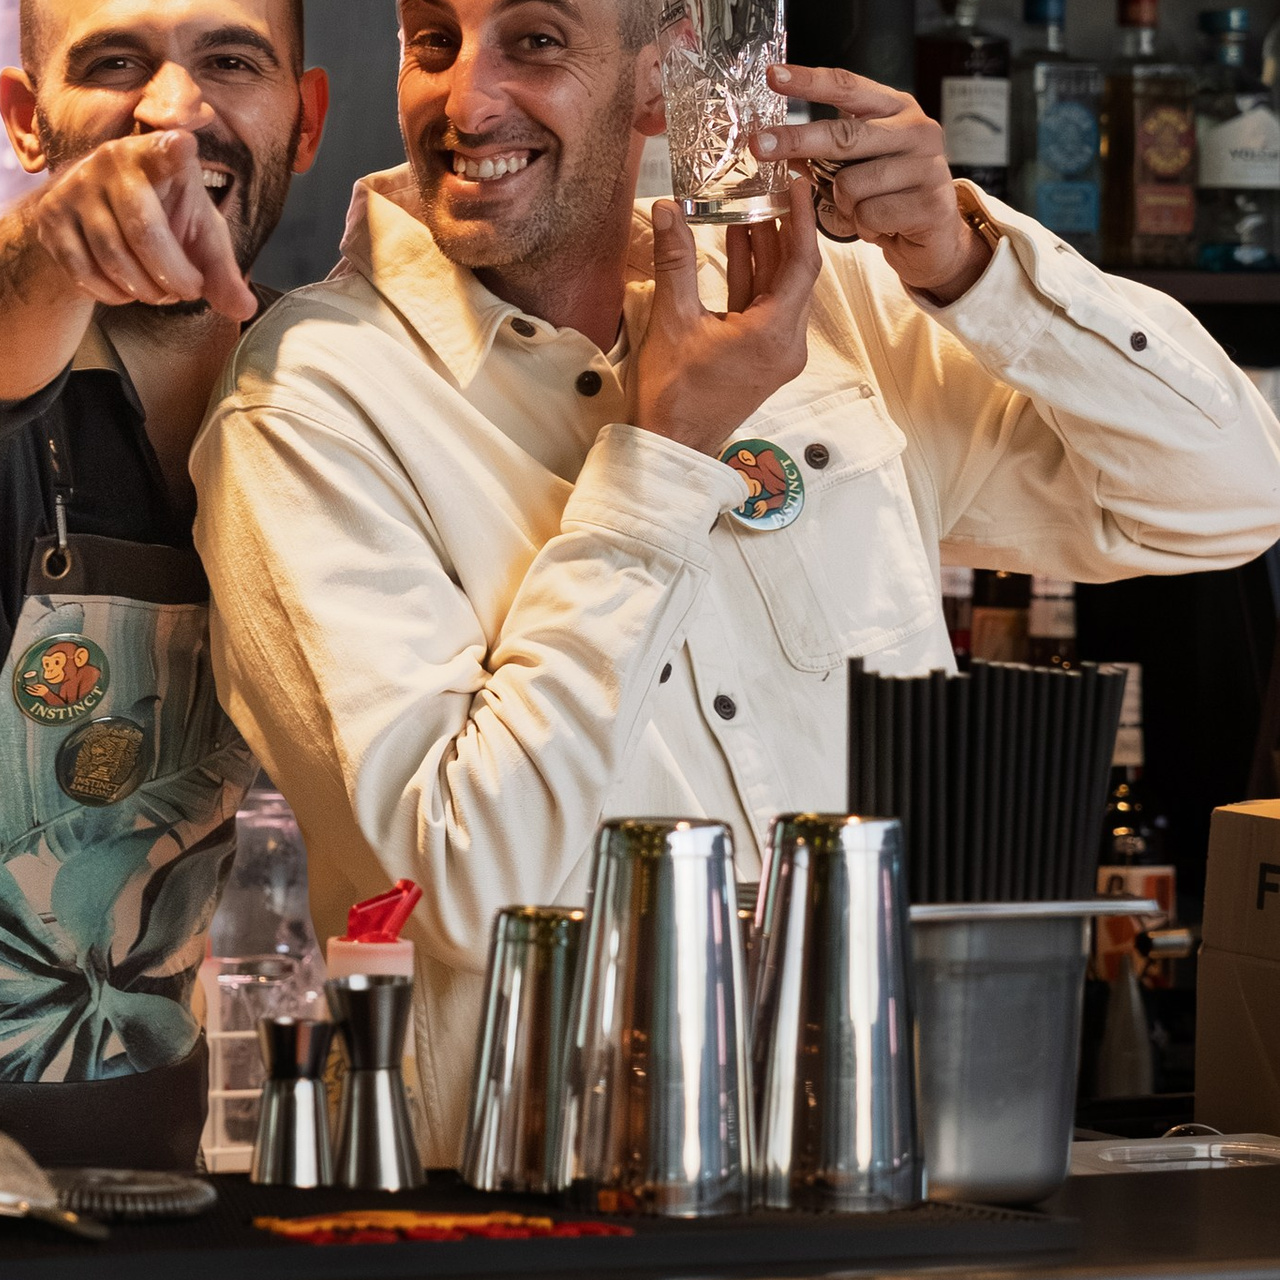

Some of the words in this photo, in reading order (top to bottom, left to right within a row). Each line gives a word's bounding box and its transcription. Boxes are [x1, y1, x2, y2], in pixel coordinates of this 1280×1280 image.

[771, 458, 801, 527] INSTINCT
[30, 684, 104, 720] INSTINCT
[73, 775, 121, 793] INSTINCT
